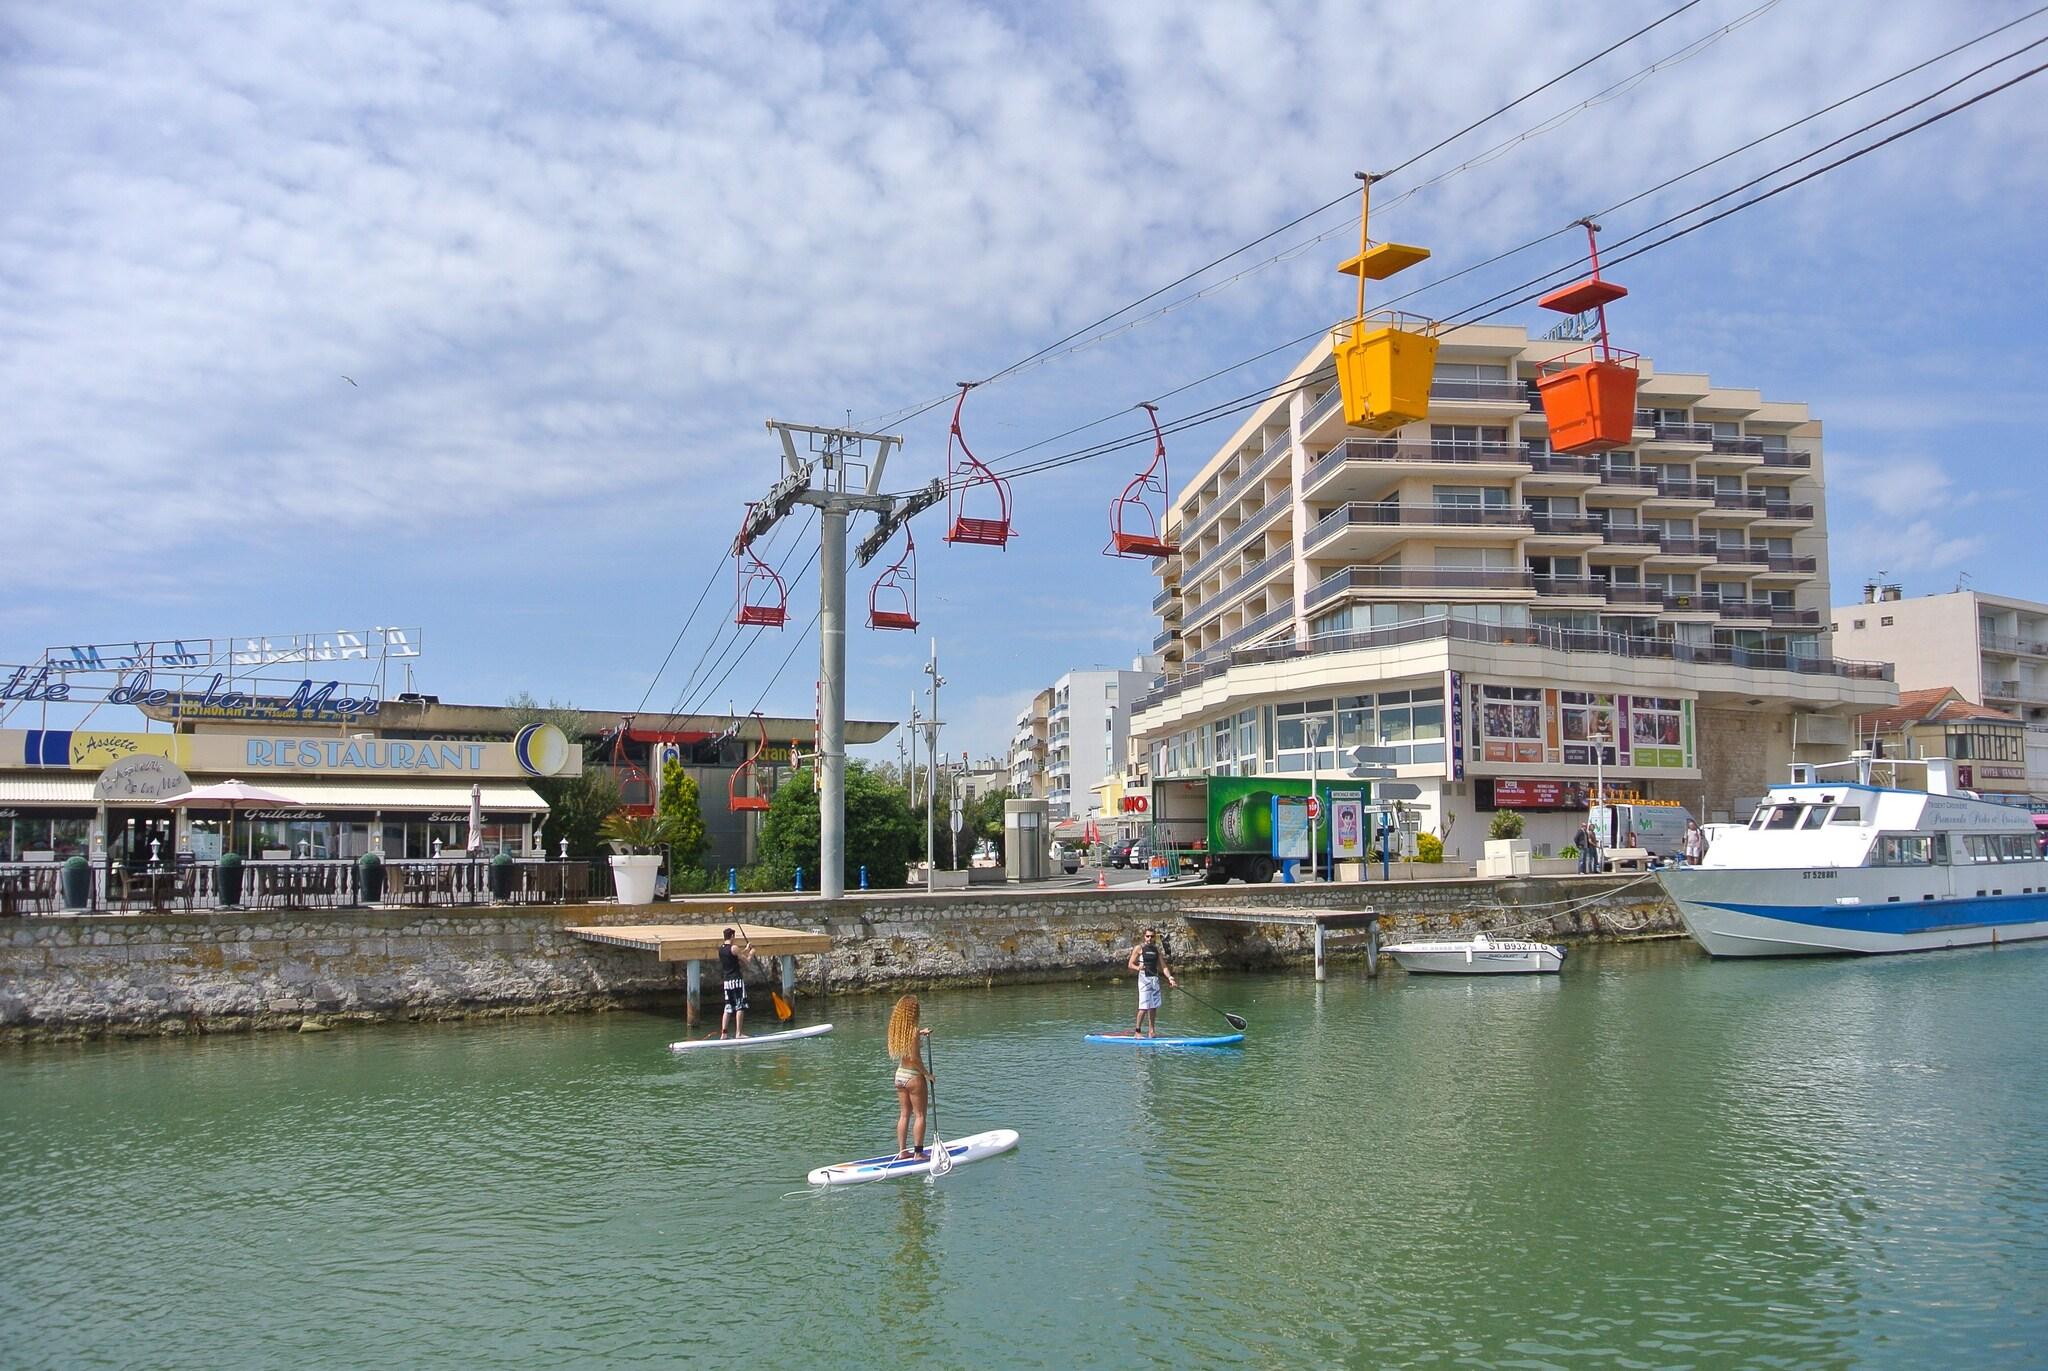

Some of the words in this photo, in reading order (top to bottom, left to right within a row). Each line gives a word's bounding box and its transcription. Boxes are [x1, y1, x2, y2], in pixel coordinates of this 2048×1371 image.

[110, 670, 168, 706] de
[201, 673, 243, 708] la
[283, 679, 380, 716] Mer
[246, 739, 486, 770] RESTAURANT
[244, 808, 326, 820] Grillades
[428, 812, 488, 822] Salas
[1803, 871, 1812, 879] ST
